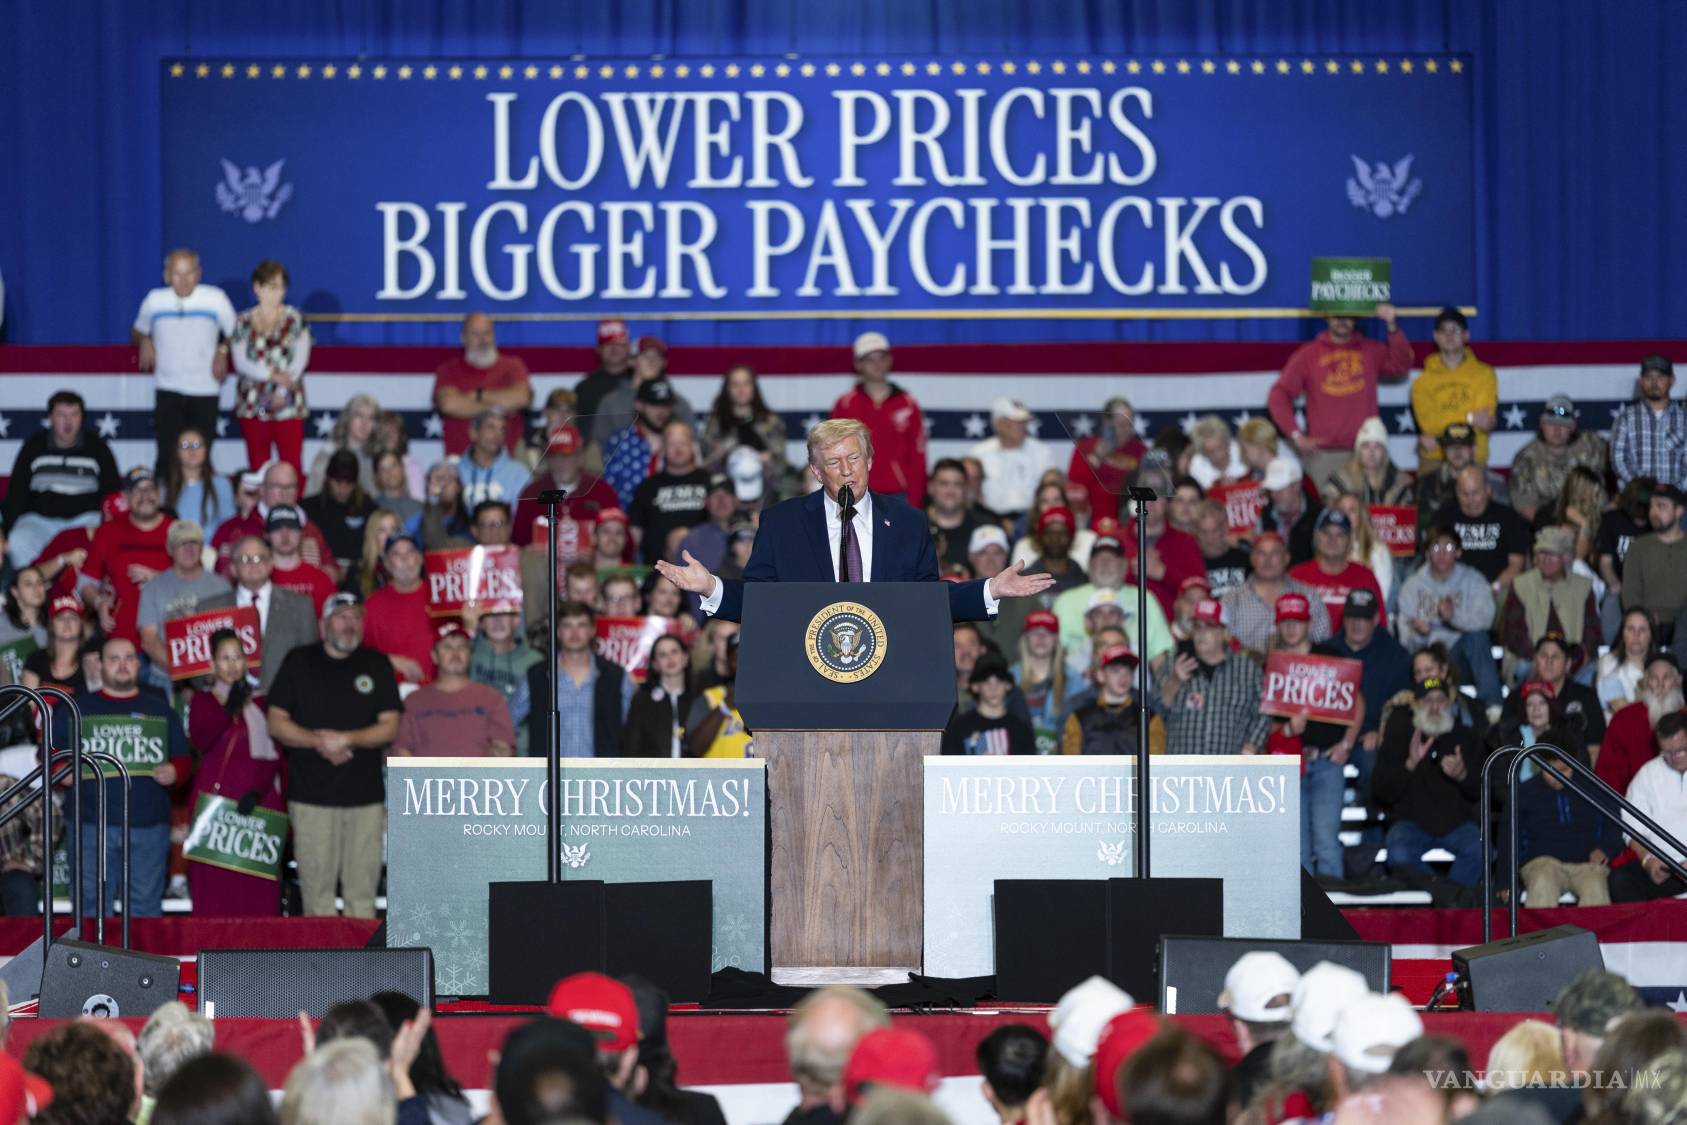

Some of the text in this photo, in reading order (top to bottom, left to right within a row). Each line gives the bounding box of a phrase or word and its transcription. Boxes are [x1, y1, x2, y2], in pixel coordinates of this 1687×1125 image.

[486, 86, 1157, 191] LOWER PRICES
[375, 195, 1268, 300] BIGGER PAYCHECKS
[1311, 280, 1392, 300] PAYCHECKS
[430, 568, 517, 603] PRIES
[808, 604, 844, 640] PRESIDENT
[867, 614, 884, 648] UNITED
[170, 624, 257, 668] PRIS
[818, 663, 840, 679] SEAL
[853, 654, 881, 679] STATES
[1289, 662, 1338, 679] LOWER
[1266, 672, 1355, 711] PRICES
[93, 724, 143, 739] LOWER
[402, 778, 530, 816] MERRY
[939, 776, 1066, 815] MERRY
[192, 818, 281, 865] PRICES
[463, 824, 691, 837] ROCKY MOUT, NORTH CAROLINA
[1000, 822, 1048, 834] ROCKY
[1107, 822, 1155, 834] NOR
[1158, 821, 1228, 834] CAROLINA
